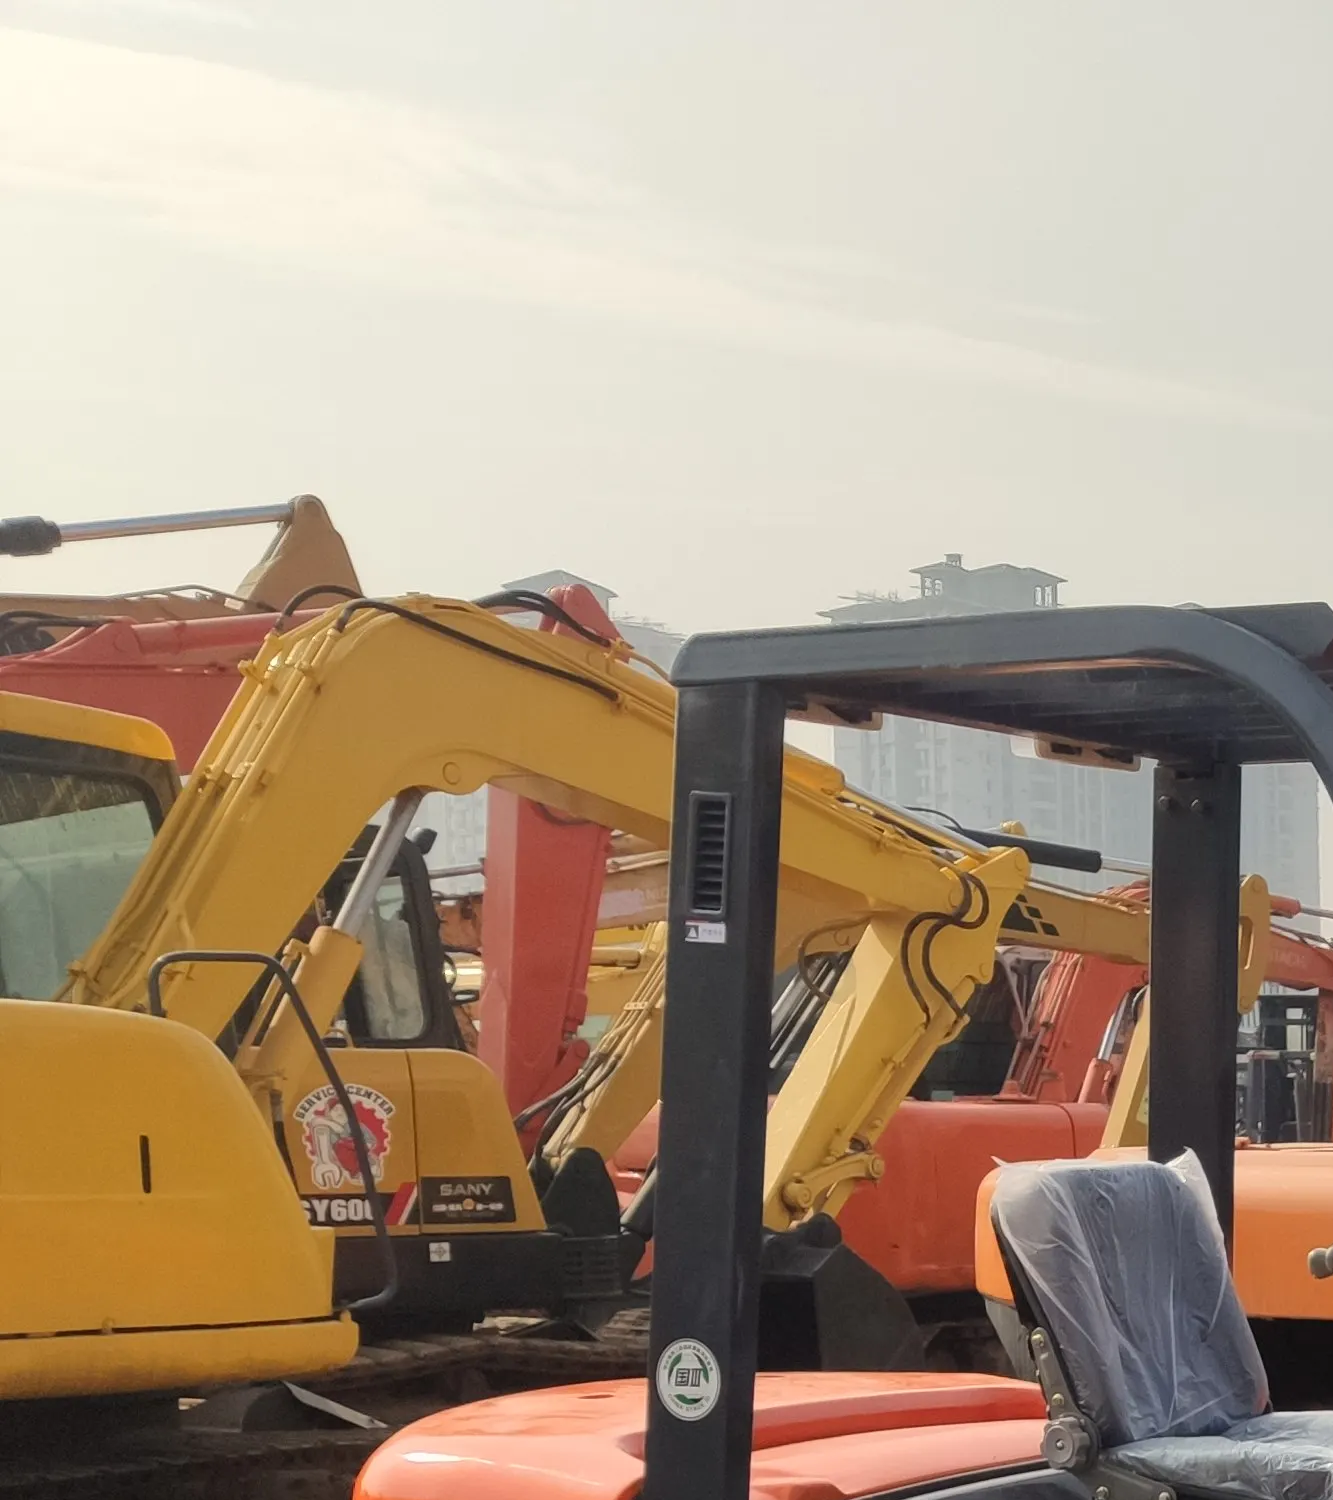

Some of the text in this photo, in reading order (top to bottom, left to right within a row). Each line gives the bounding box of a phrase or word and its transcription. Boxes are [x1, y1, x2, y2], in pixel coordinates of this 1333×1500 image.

[295, 1085, 394, 1119] SERVIC CENTER
[439, 1184, 494, 1196] SANY
